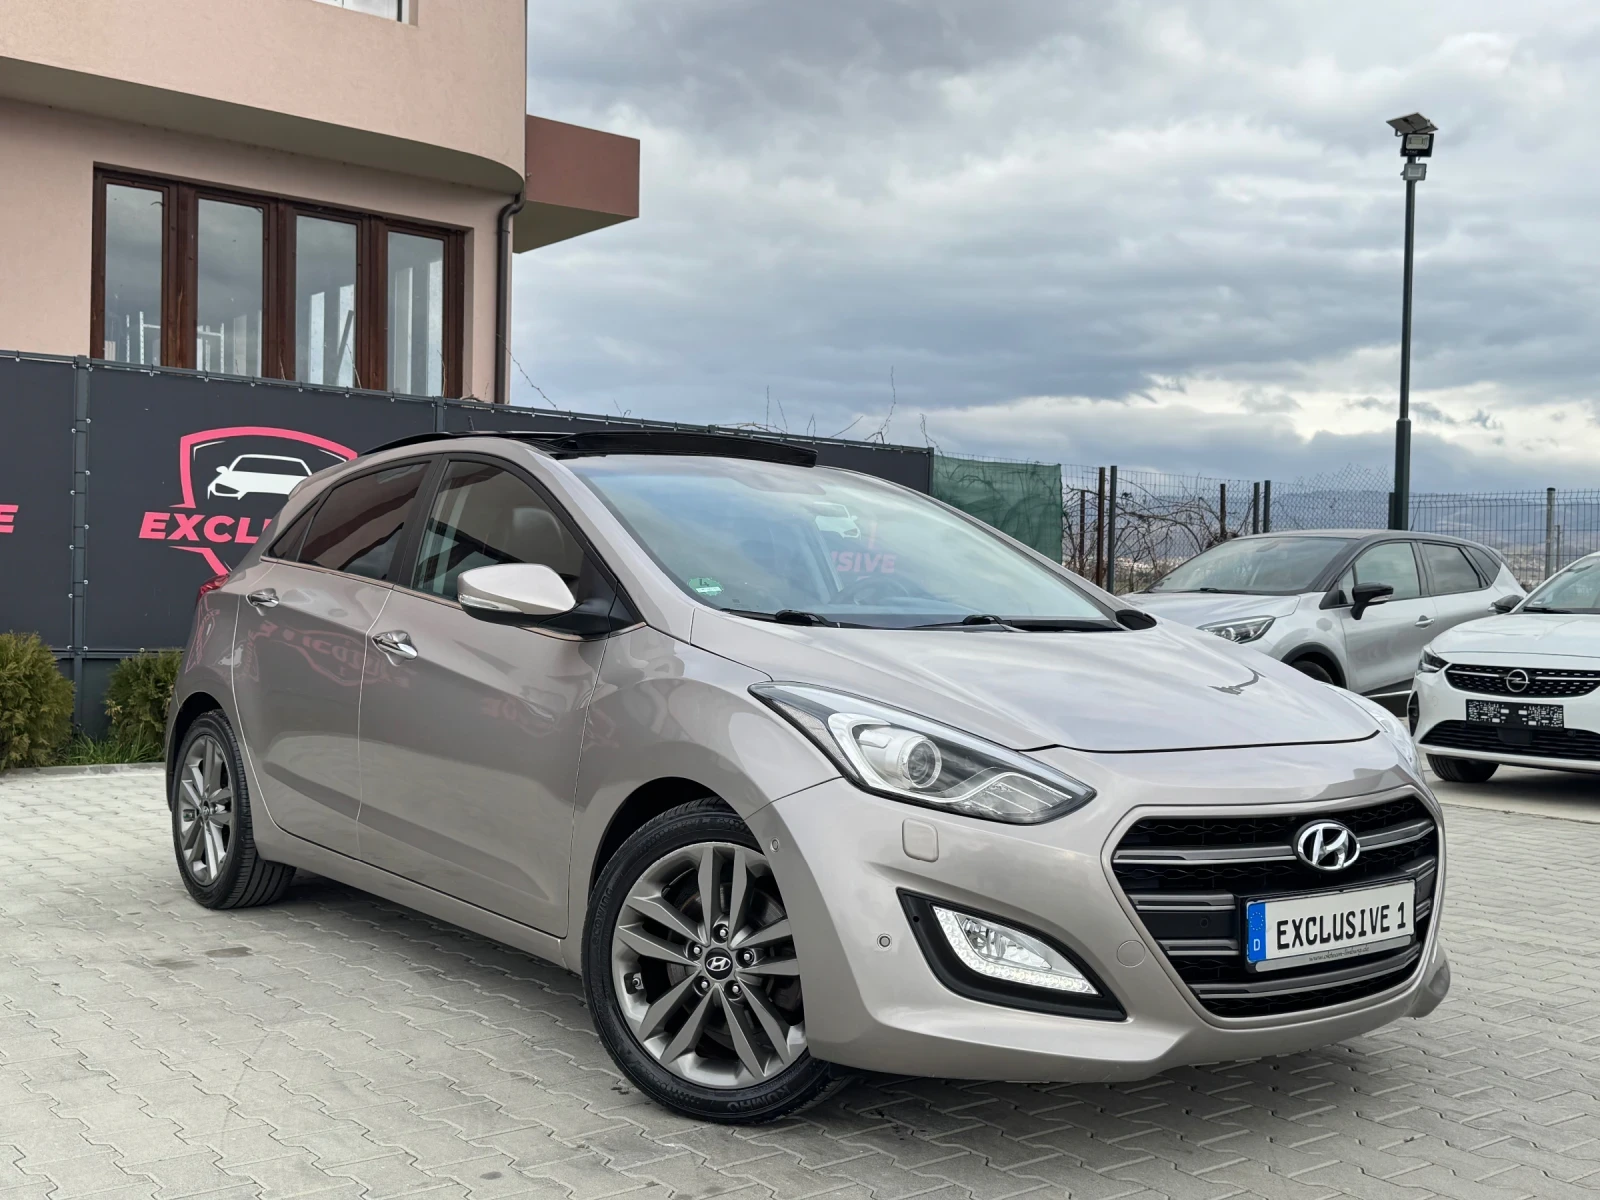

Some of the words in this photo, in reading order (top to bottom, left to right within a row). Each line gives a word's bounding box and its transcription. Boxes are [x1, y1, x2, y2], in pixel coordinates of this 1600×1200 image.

[139, 511, 273, 544] EXCL
[1276, 904, 1390, 950] EXCLUSIVE
[1397, 901, 1406, 929] 1
[1253, 938, 1261, 951] D
